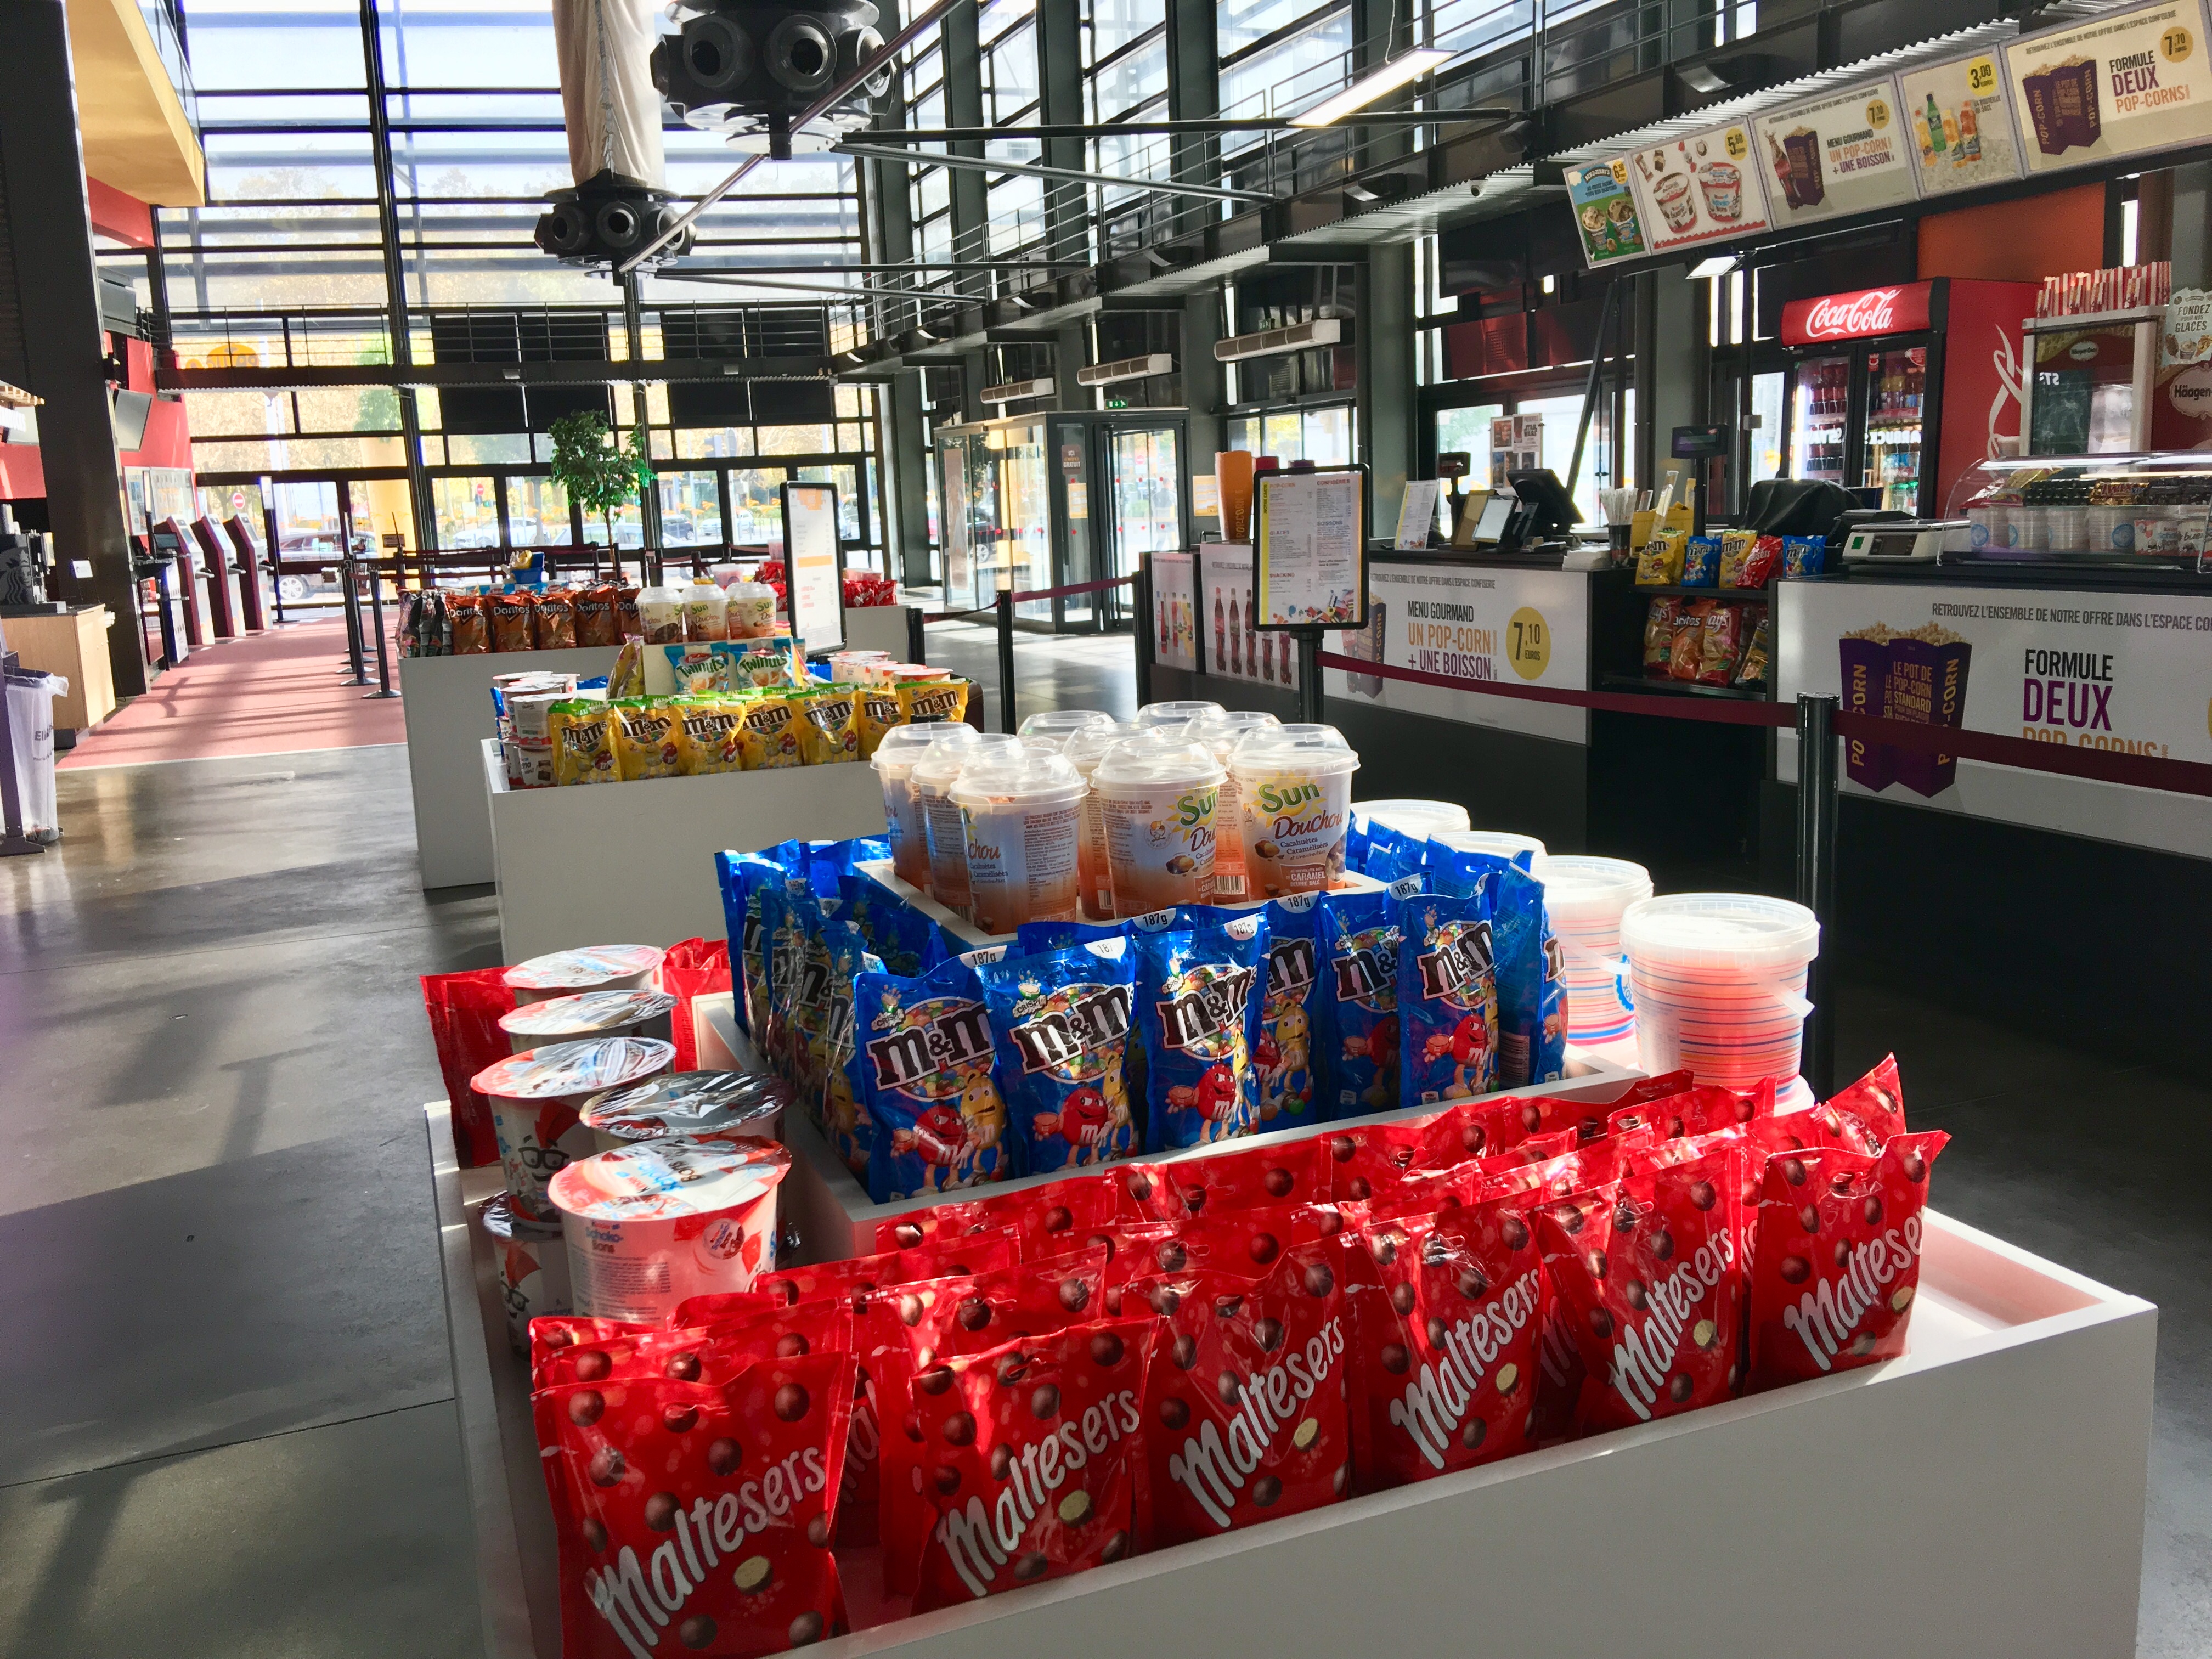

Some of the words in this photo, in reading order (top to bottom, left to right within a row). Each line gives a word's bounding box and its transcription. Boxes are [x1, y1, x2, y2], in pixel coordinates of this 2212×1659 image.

[2109, 50, 2155, 73] FORMULE
[1971, 65, 1991, 88] 3,00
[2112, 65, 2159, 97] DEUX
[1827, 136, 1843, 148] MENU
[1843, 129, 1874, 144] GOURMAND
[1829, 149, 1842, 163] UN
[1839, 159, 1856, 173] UNE
[1857, 151, 1891, 169] BOISSON
[1806, 289, 1903, 337] Coca-Cola
[2177, 304, 2211, 316] FONDEZ
[2175, 321, 2207, 333] GLACES
[449, 607, 483, 618] Doritos
[494, 606, 530, 616] Doritos
[577, 602, 610, 612] Doritos
[691, 604, 709, 614] Sun
[756, 601, 774, 611] Sun
[1408, 600, 1428, 619] MENU
[1430, 603, 1474, 623] GOURMAND
[1932, 603, 1979, 618] RETROUVEZ
[1981, 606, 2034, 621] L'ENSEMBLE
[2036, 608, 2048, 621] DE
[2050, 608, 2080, 623] NOTRE
[2083, 611, 2114, 626] OFFRE
[2116, 612, 2143, 627] DANS
[2145, 613, 2192, 630] L'ESPACE
[1408, 623, 1424, 646] UN
[738, 654, 788, 675] Twinuts
[1408, 654, 1417, 669] +
[1419, 649, 1440, 673] UNE
[1443, 653, 1491, 680] BOISSON
[1525, 650, 1541, 661] EUROS
[2025, 648, 2114, 681] FORMULE
[676, 657, 725, 677] Twinuts
[1894, 661, 1903, 675] LE
[1904, 664, 1919, 679] POT
[1921, 667, 1932, 682] DE
[1894, 676, 1932, 698] POP-CORN
[1894, 693, 1931, 713] STANDARD
[2023, 678, 2113, 731] DEUX
[1259, 783, 1320, 813] Sun
[1280, 836, 1318, 848] Cacahuètes
[1286, 841, 1328, 855] Caramélisées
[1291, 871, 1325, 881] CARAMEL
[1394, 882, 1419, 896] 187g
[1287, 895, 1311, 908] 187g
[1142, 913, 1168, 927] 187g
[1233, 923, 1255, 936] 187g
[1017, 997, 1042, 1014] CRISPY
[1607, 1227, 1734, 1421] Maltesers
[1390, 1268, 1539, 1470] Maltesers
[1169, 1316, 1344, 1528] Maltesers
[936, 1390, 1140, 1599] Maltesers
[584, 1447, 827, 1659] Maltesers
